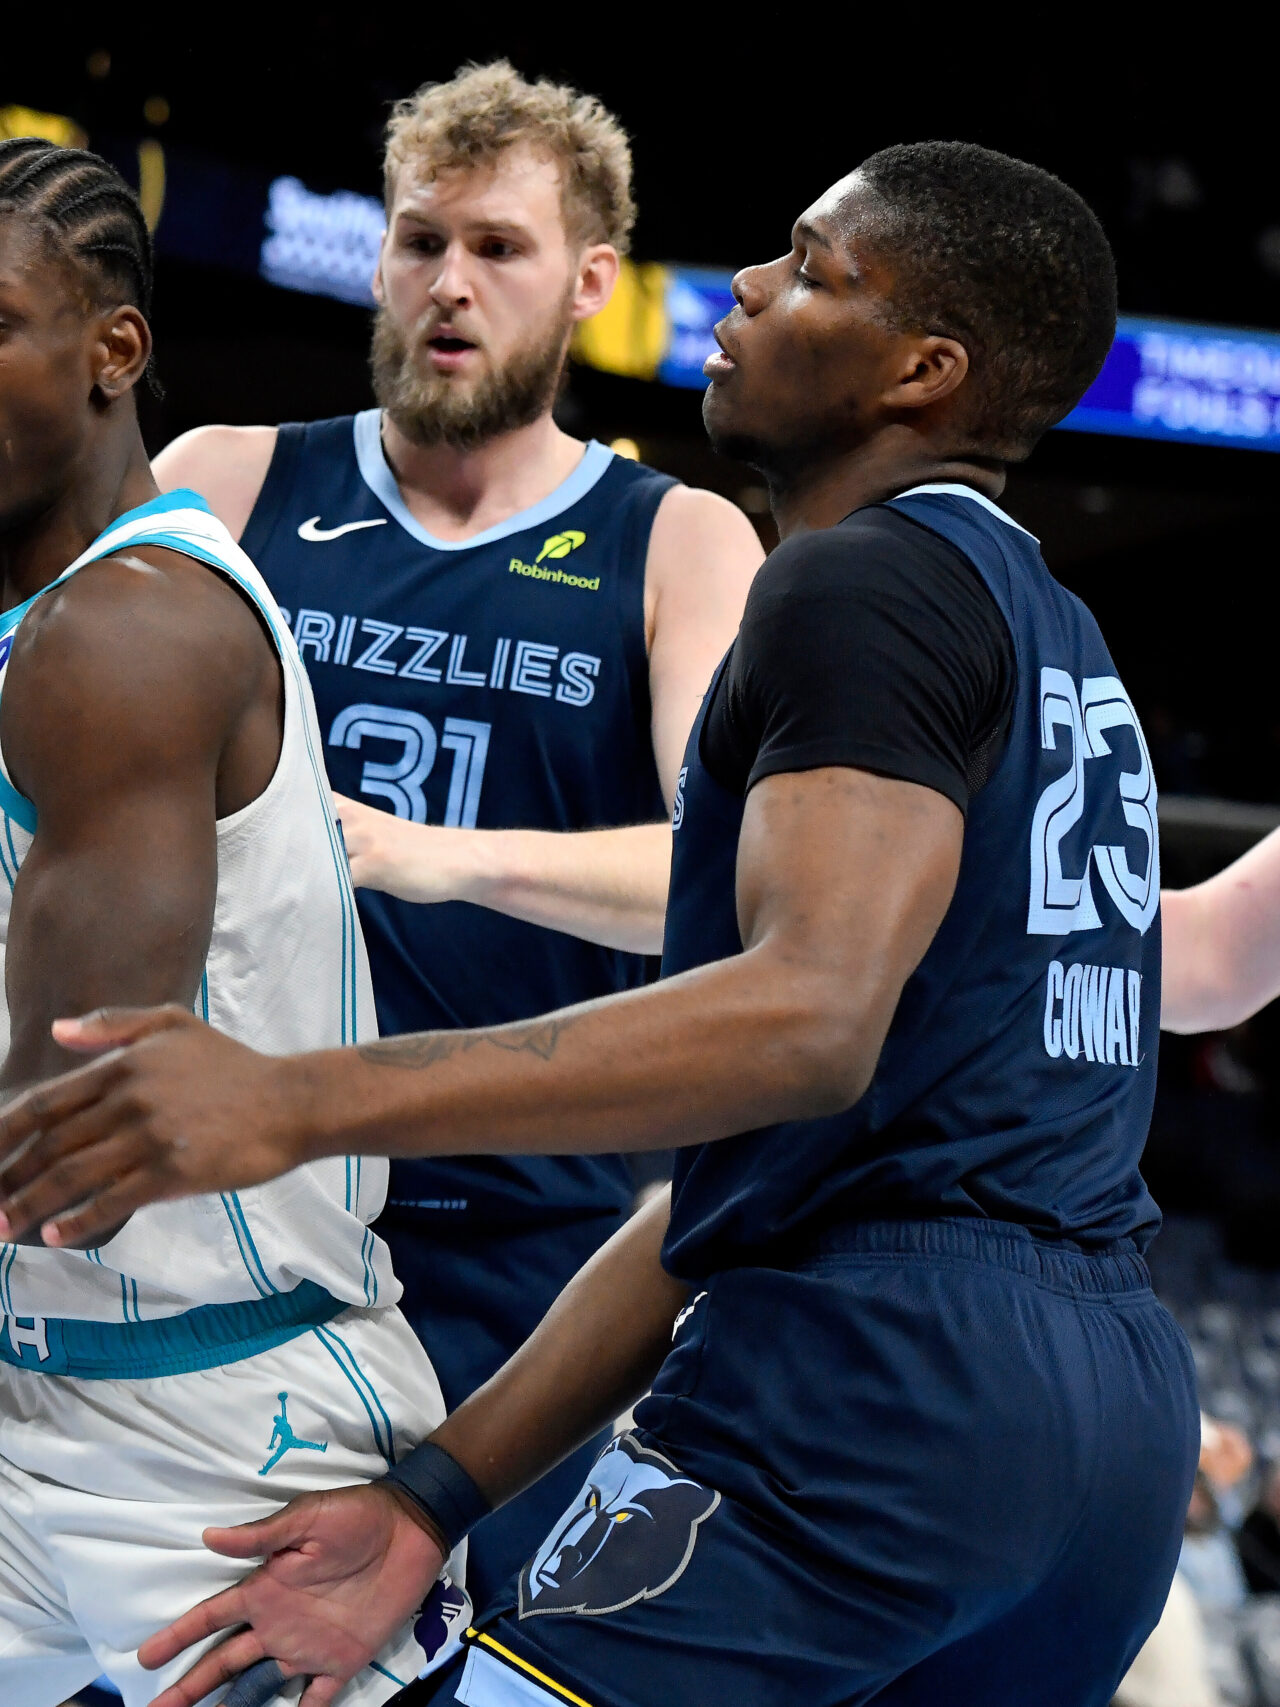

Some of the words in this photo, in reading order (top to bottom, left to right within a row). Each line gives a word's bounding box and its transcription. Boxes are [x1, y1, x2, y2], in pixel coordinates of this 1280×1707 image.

[509, 558, 600, 591] Robinhood
[278, 606, 601, 707] RIZZLIES
[328, 703, 492, 829] 31
[1026, 666, 1161, 936] 23
